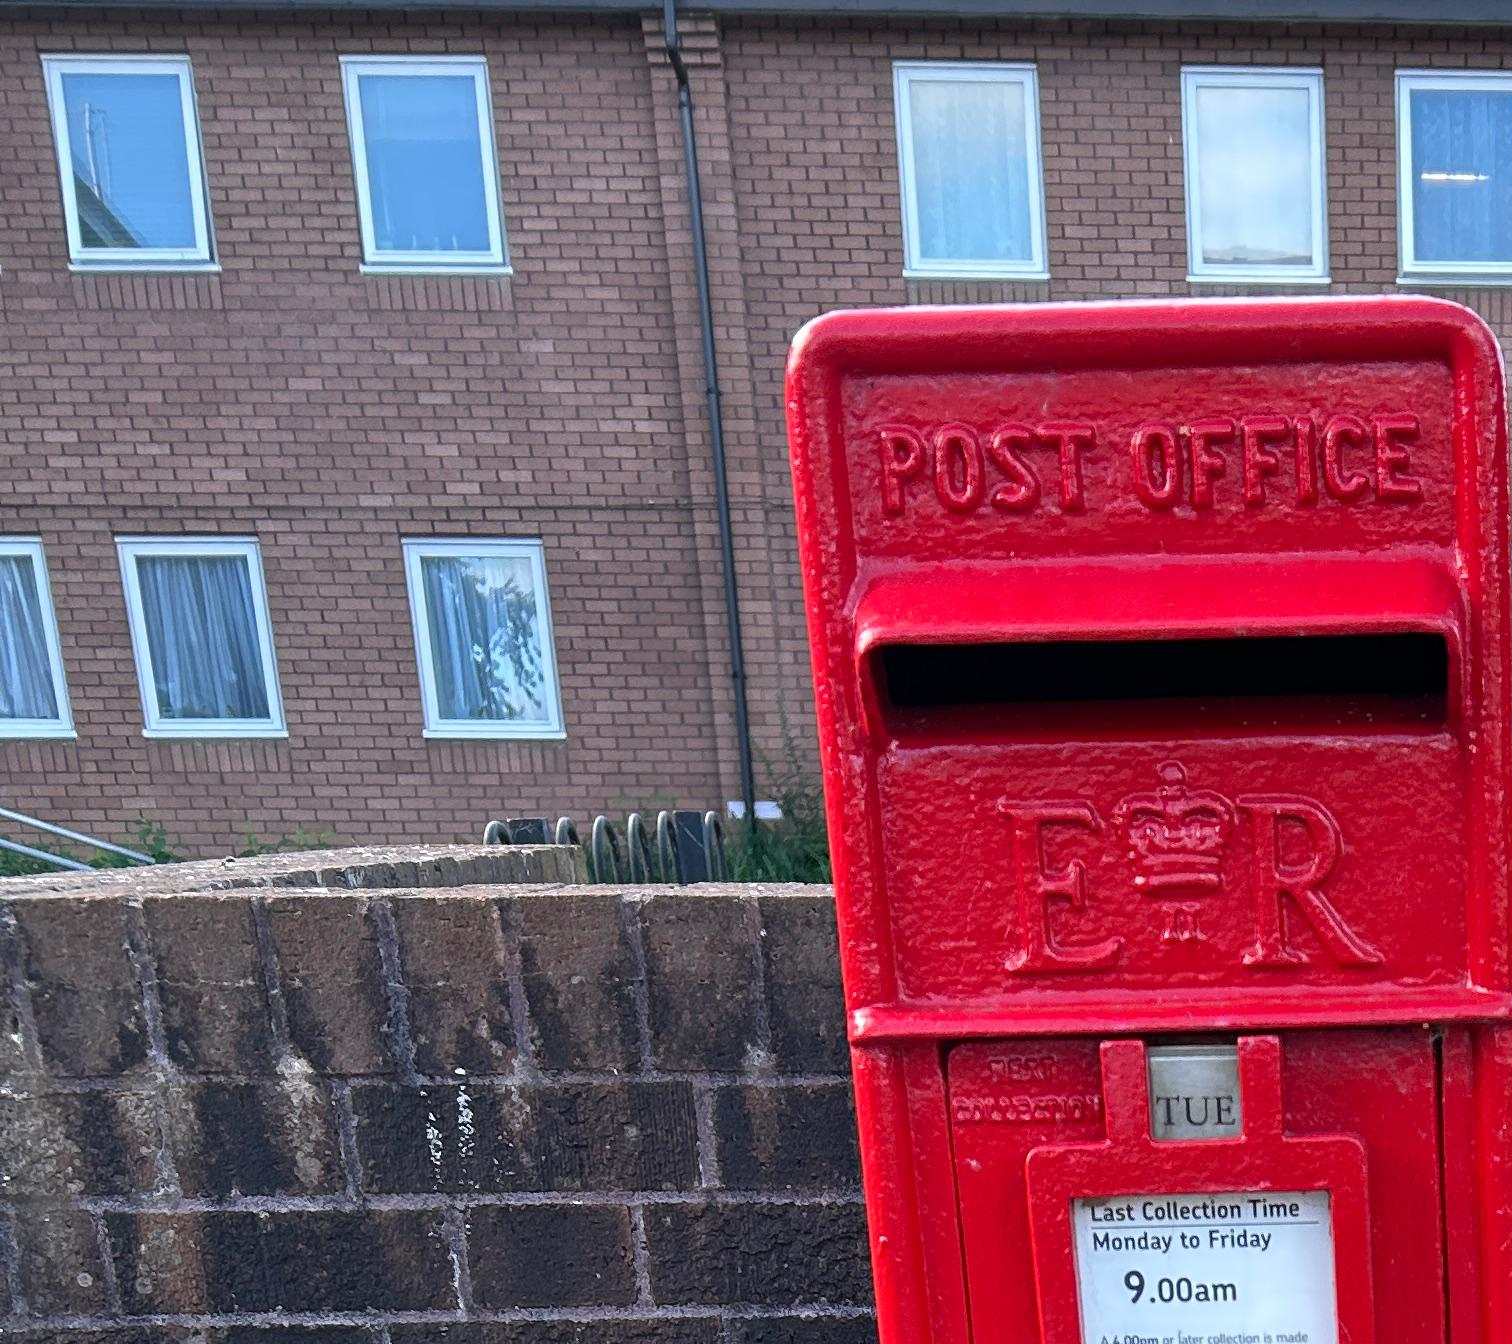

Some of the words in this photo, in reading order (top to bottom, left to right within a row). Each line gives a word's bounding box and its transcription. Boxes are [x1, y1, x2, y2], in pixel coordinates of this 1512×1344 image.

[879, 422, 1096, 516] POST
[1130, 413, 1423, 508] OFFICE
[998, 797, 1126, 975] E
[1236, 792, 1386, 967] R
[1156, 1096, 1236, 1127] TUE
[1091, 1202, 1135, 1222] Last
[1142, 1201, 1242, 1221] Collection
[1250, 1200, 1300, 1218] Time
[1093, 1232, 1171, 1253] Monday
[1180, 1232, 1200, 1250] to
[1208, 1230, 1271, 1251] Friday
[1124, 1270, 1237, 1304] 9.00am
[1207, 1333, 1260, 1344] collection
[1263, 1333, 1272, 1344] is
[1276, 1331, 1308, 1344] made
